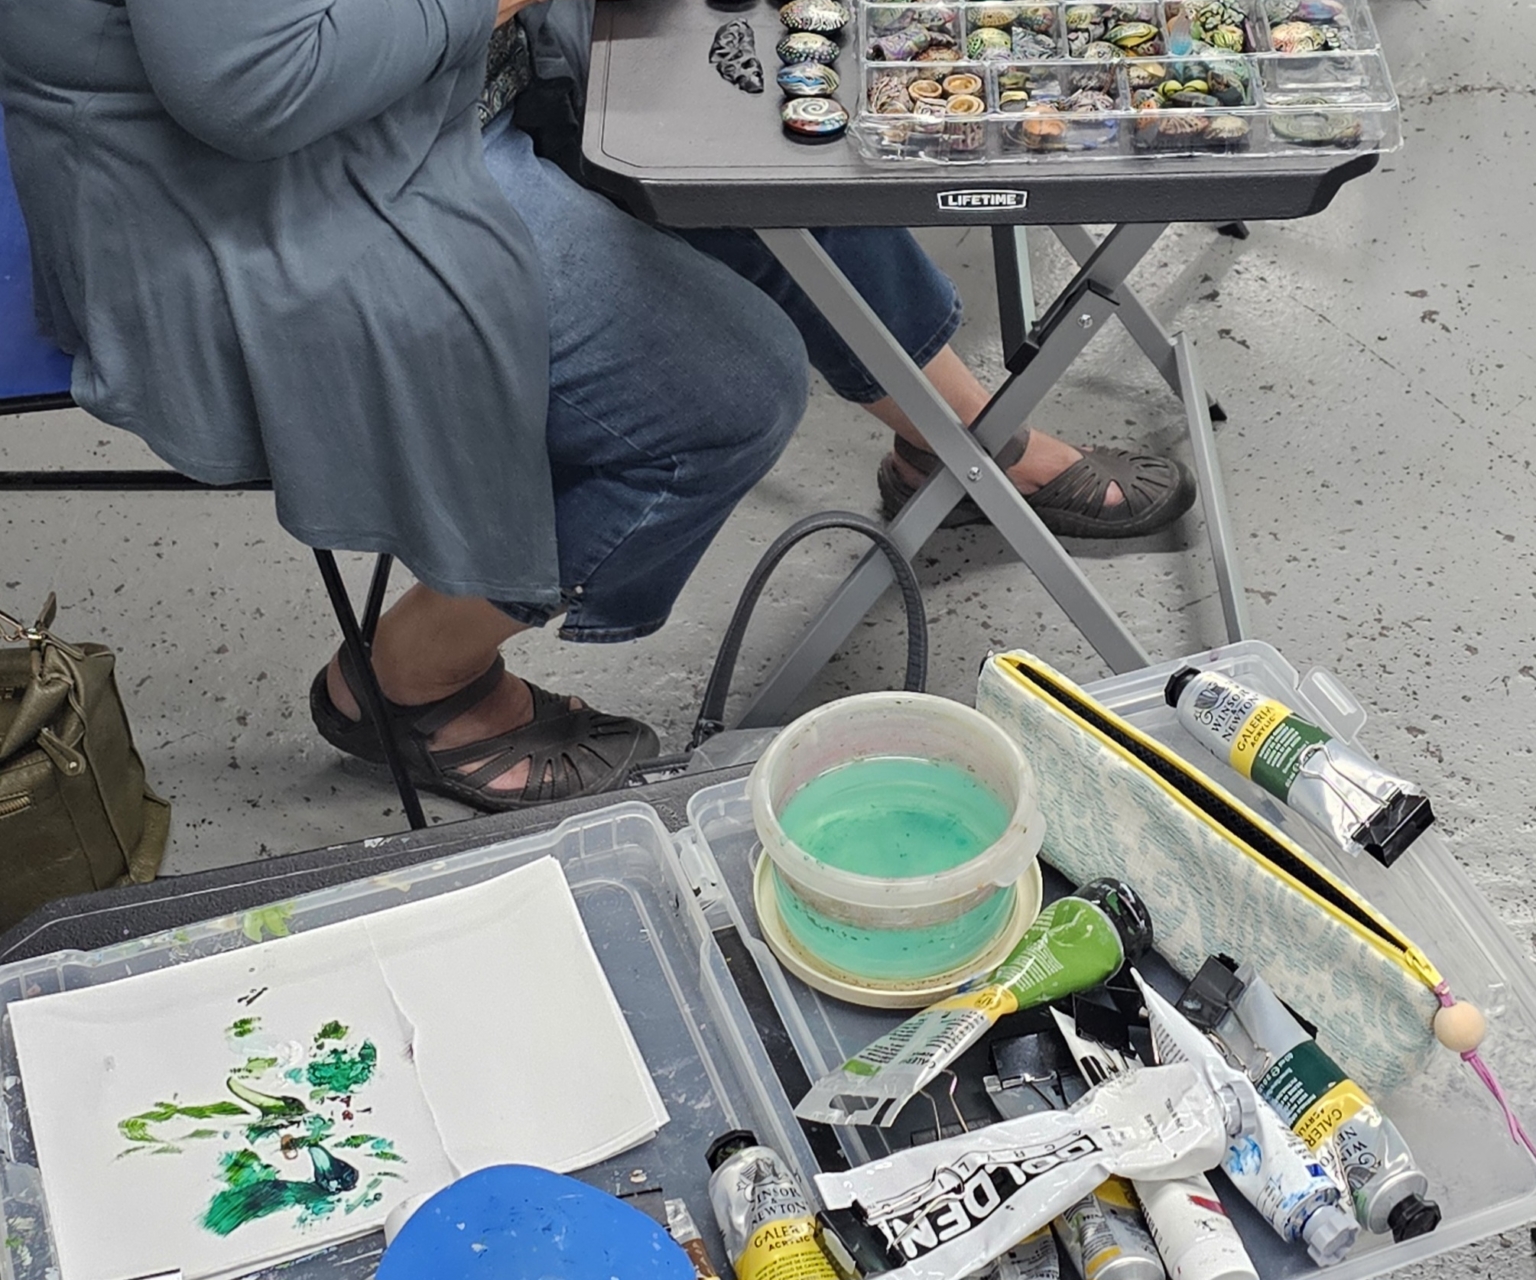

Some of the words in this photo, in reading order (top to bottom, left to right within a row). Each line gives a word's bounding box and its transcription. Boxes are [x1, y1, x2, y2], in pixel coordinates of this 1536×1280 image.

[947, 193, 1017, 206] LIFETIME
[1211, 689, 1250, 733] WINSOR
[1222, 695, 1259, 742] NEWTON
[1237, 705, 1275, 752] GALERIA
[1250, 715, 1275, 749] ACRYLIC
